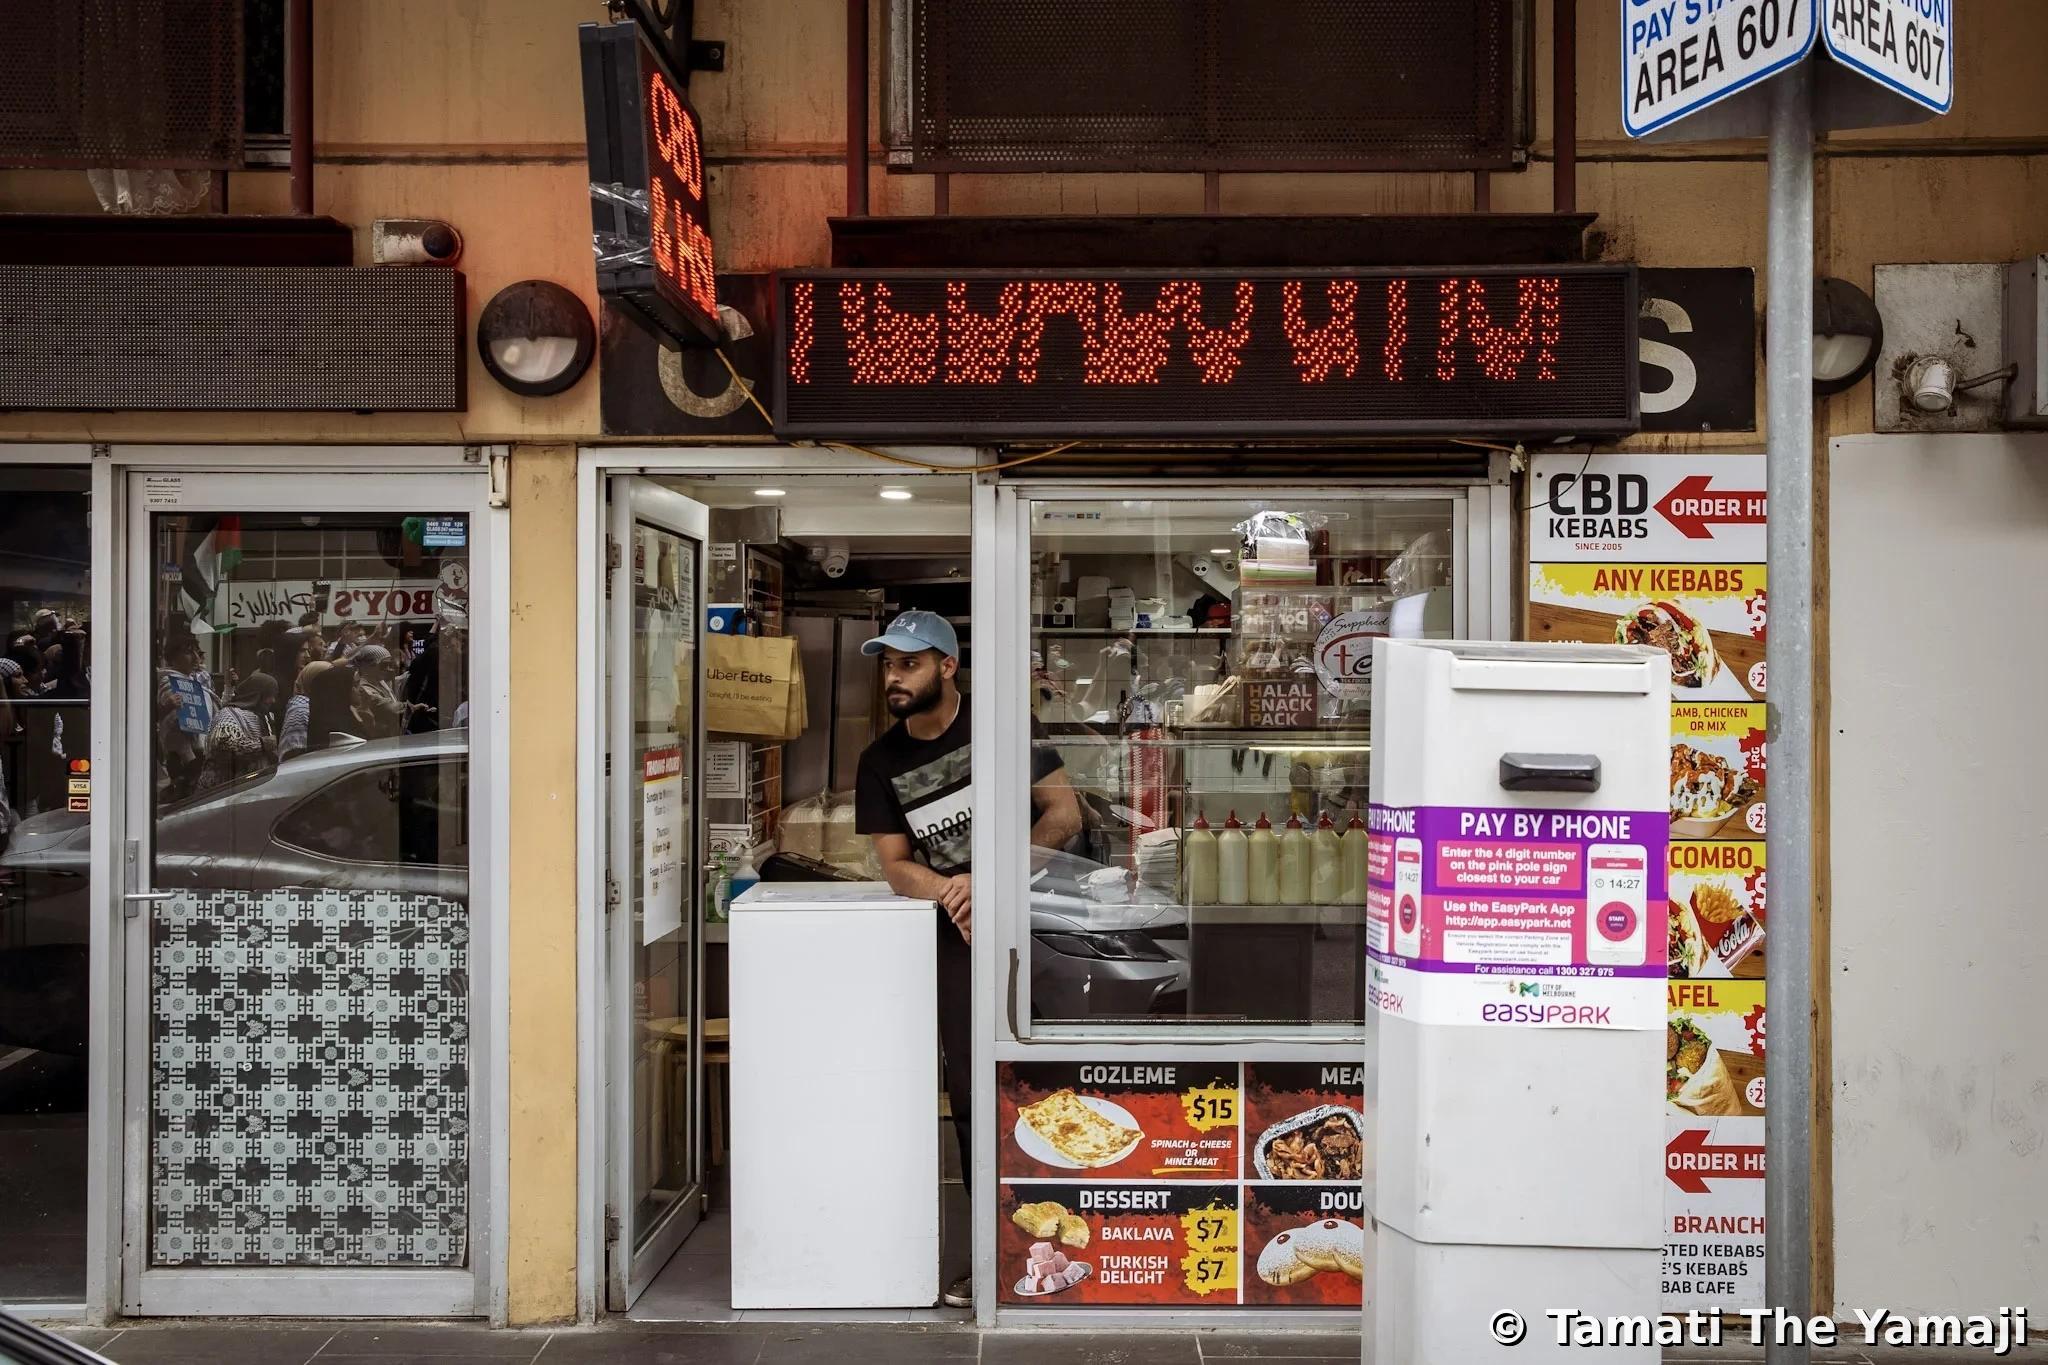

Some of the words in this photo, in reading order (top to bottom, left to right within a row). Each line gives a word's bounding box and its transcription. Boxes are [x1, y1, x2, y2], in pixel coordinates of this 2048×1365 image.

[1633, 1, 1676, 55] PAY
[1832, 0, 1898, 64] AREA
[1906, 21, 1945, 86] 607
[1634, 25, 1724, 114] AREA
[1737, 0, 1797, 60] 607
[1549, 474, 1648, 516] CBD
[1671, 498, 1741, 516] ORDER
[1549, 518, 1648, 539] KEBABS
[1575, 543, 1600, 551] SINCE
[1602, 543, 1622, 551] 2005
[1593, 569, 1644, 591] ANY
[1650, 569, 1744, 592] KEBABS
[1334, 615, 1389, 632] Supplied
[706, 668, 738, 681] Uber
[740, 671, 773, 684] Eats
[1249, 684, 1312, 698] HALAL
[1249, 699, 1313, 712] SNACK
[1703, 708, 1748, 718] CHICKEN
[1249, 713, 1299, 726] PACK
[1690, 721, 1706, 731] OR
[1707, 721, 1727, 731] MIX
[1751, 746, 1760, 769] LRG
[1382, 810, 1415, 833] PHONE
[1460, 812, 1507, 836] PAY
[1513, 814, 1544, 838] BY
[1551, 815, 1631, 839] PHONE
[1441, 847, 1473, 858] Enter
[1474, 847, 1493, 859] the
[1495, 848, 1502, 859] 4
[1505, 848, 1530, 861] digit
[1533, 849, 1577, 860] number
[1669, 846, 1753, 869] COMBO
[1450, 861, 1465, 870] on
[1468, 860, 1486, 870] the
[1488, 860, 1513, 874] pink
[1515, 860, 1540, 874] pole
[1543, 861, 1567, 875] sign
[1456, 872, 1498, 883] closest
[1500, 873, 1512, 883] to
[1514, 874, 1540, 886] your
[1542, 875, 1561, 885] car
[1609, 879, 1640, 889] 14:27
[1443, 901, 1467, 912] Use
[1469, 901, 1489, 912] the
[1491, 902, 1547, 916] EasyPark
[1550, 903, 1575, 916] App
[1445, 915, 1572, 929] http://app.easypark.net
[1474, 965, 1489, 974] For
[1491, 965, 1537, 974] assistance
[1538, 966, 1554, 975] call
[1555, 965, 1578, 976] 1300
[1580, 966, 1596, 976] 327
[1597, 966, 1614, 977] 975
[1542, 990, 1576, 998] MELBOURNE
[1079, 1065, 1176, 1085] GOZLEME
[1193, 1098, 1233, 1122] $15
[1150, 1140, 1190, 1149] SPINACH
[1190, 1141, 1198, 1149] &
[1199, 1140, 1232, 1149] CHEESE
[1185, 1149, 1198, 1157] OR
[1165, 1157, 1192, 1166] MINCE
[1193, 1157, 1219, 1166] MEAT
[1668, 1152, 1738, 1171] ORDER
[1079, 1190, 1171, 1210] DESSERT
[1321, 1192, 1362, 1210] DOU
[1196, 1218, 1224, 1243] $7
[1674, 1216, 1765, 1234] BRANCH
[1102, 1227, 1174, 1241] BAKLAVA
[1703, 1244, 1765, 1258] KEBABS
[1100, 1255, 1168, 1270] TURKISH
[1686, 1262, 1748, 1276] KEBABS
[1100, 1270, 1165, 1284] DELIGHT
[1196, 1259, 1224, 1284] $7
[1696, 1281, 1735, 1294] CAFE
